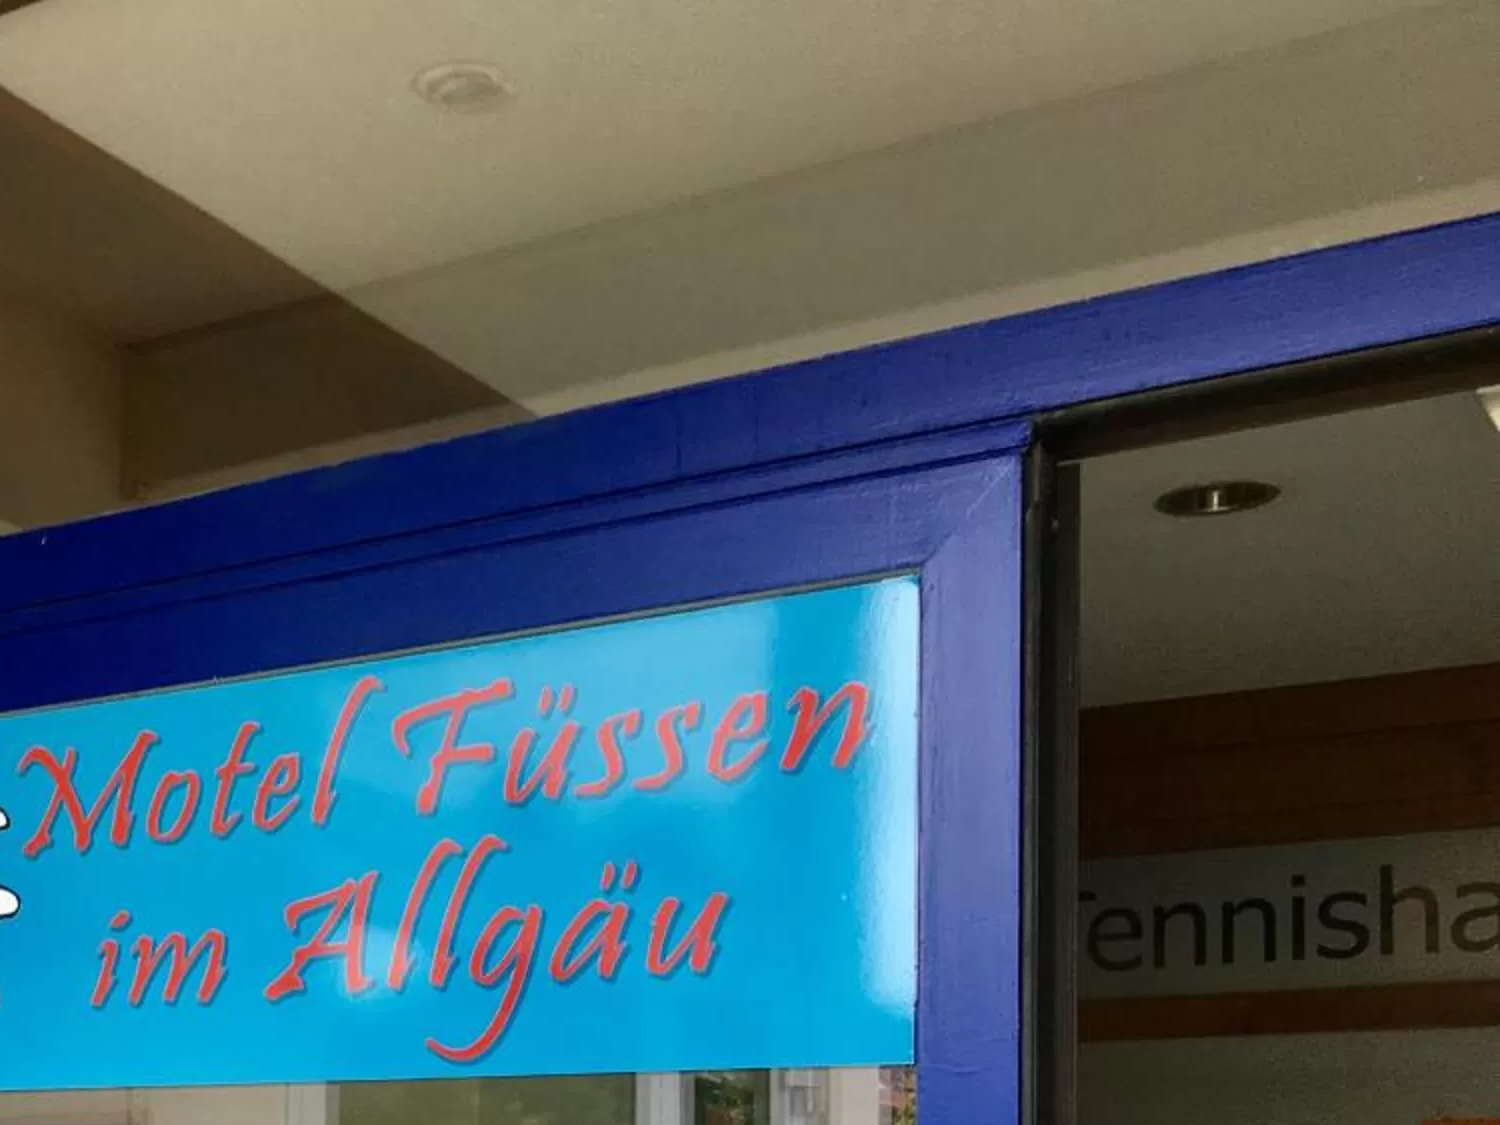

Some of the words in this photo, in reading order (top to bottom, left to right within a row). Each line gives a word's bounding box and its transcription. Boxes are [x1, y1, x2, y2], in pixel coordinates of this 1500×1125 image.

[20, 674, 384, 856] Motel
[393, 677, 871, 816] Füssen
[90, 909, 227, 1007] im
[264, 834, 729, 1061] Allgäu
